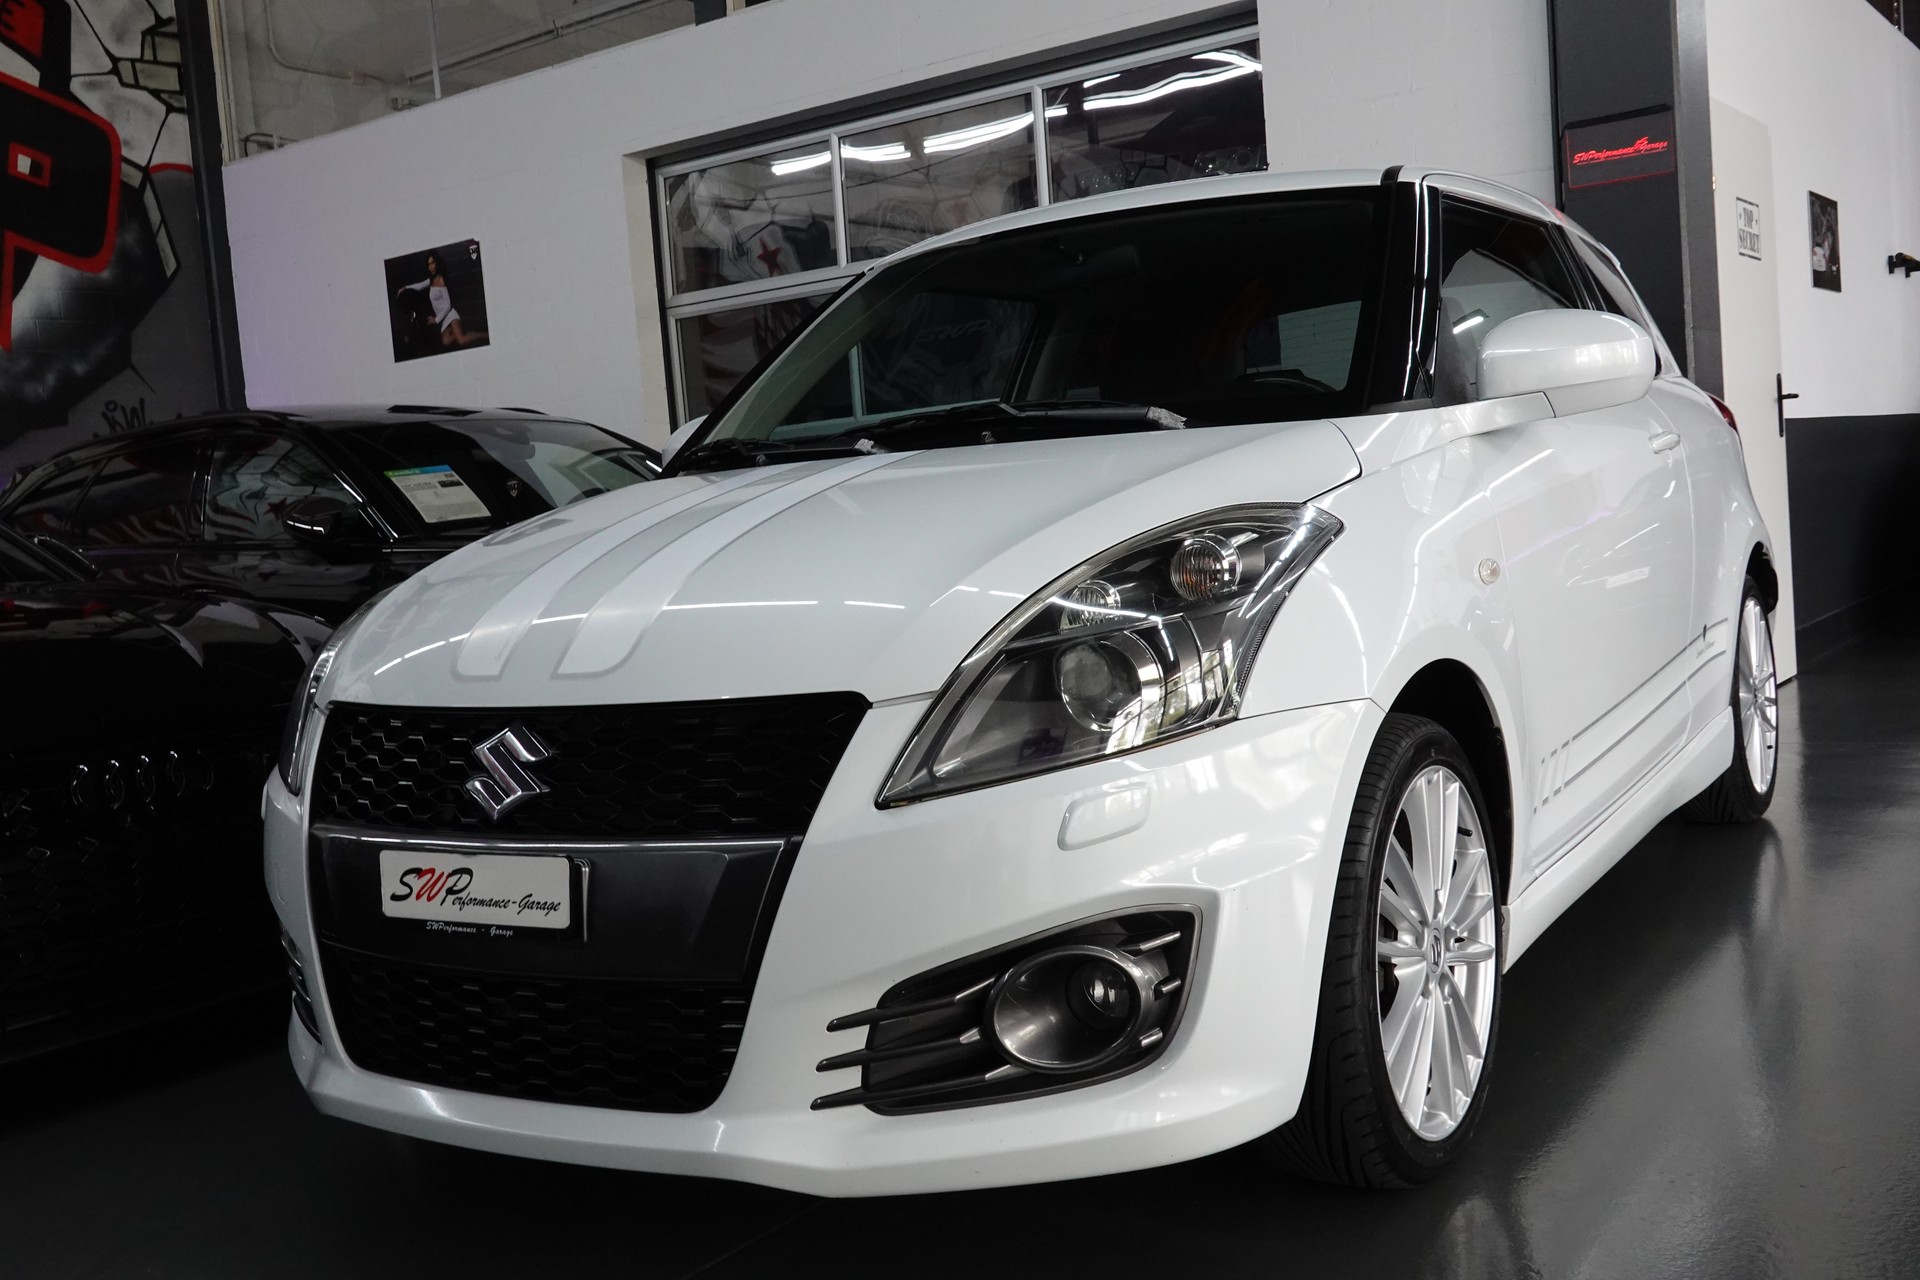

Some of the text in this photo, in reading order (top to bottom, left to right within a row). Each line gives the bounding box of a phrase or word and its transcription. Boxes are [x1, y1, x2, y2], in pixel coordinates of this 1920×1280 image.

[1743, 207, 1754, 229] TOP
[1739, 228, 1760, 254] SECRET
[426, 921, 477, 935] SWPerformance
[490, 926, 514, 937] Garage
